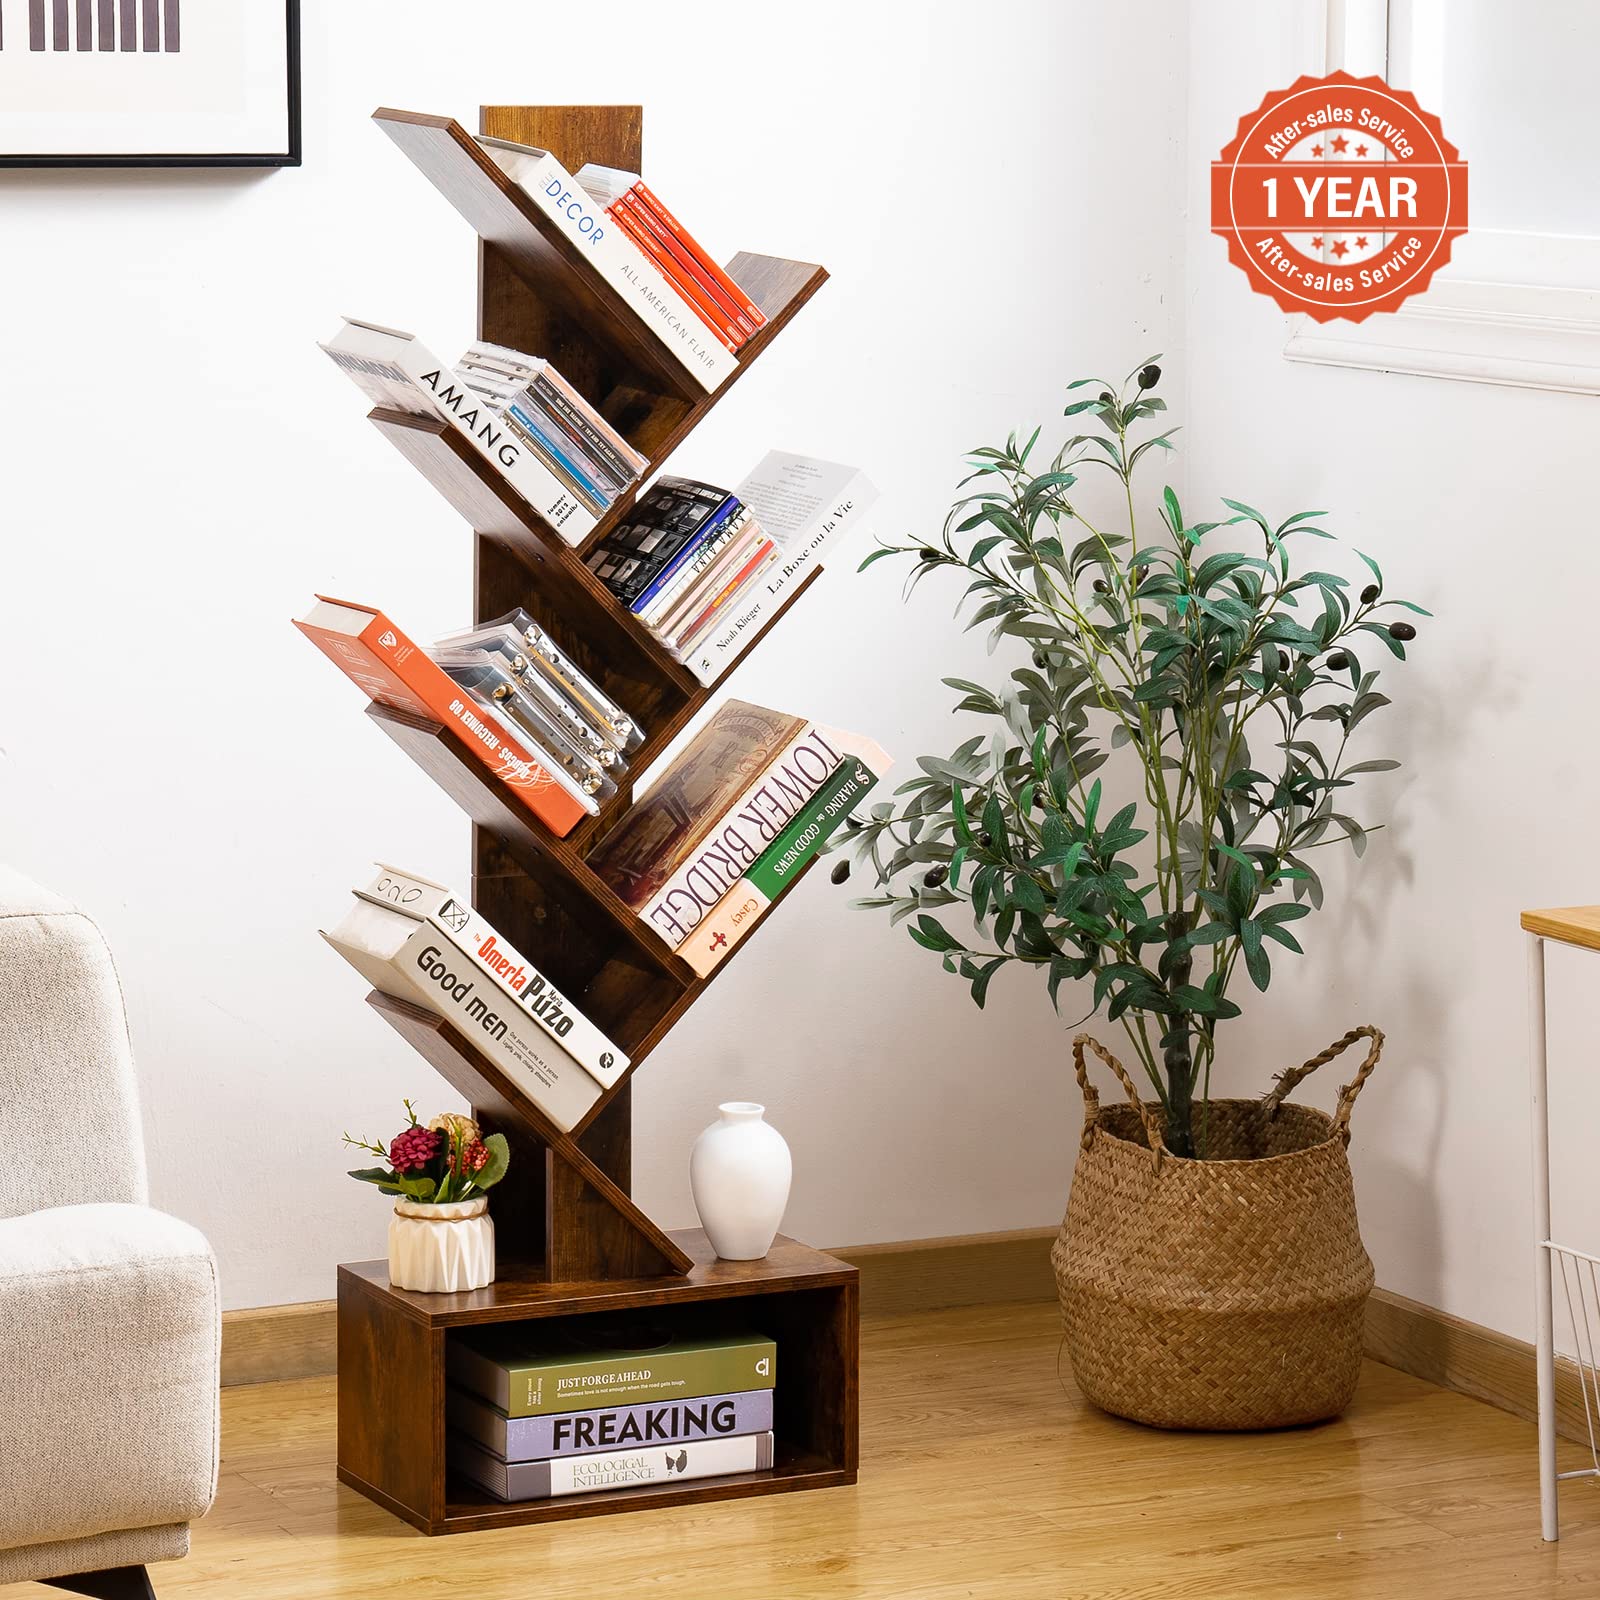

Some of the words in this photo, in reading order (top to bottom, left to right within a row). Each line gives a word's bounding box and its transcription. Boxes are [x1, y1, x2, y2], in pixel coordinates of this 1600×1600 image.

[546, 179, 604, 246] DECOR
[622, 212, 635, 226] SUPER
[633, 224, 645, 238] MARIO
[634, 202, 646, 215] SUPER
[645, 213, 656, 227] MARIO
[620, 264, 688, 341] ALL-AMERICAN
[687, 338, 716, 370] FLAIR
[420, 370, 521, 468] AMANG
[767, 578, 785, 595] La
[782, 549, 810, 578] Boxe
[810, 533, 825, 549] ou
[822, 521, 836, 534] la
[833, 501, 854, 519] Vie
[716, 629, 738, 651] Noah
[735, 603, 762, 631] Klieger
[460, 710, 500, 750] RELCOMEX
[738, 728, 846, 844] TOWER
[773, 846, 800, 876] NEWS
[794, 823, 820, 852] GOOD
[650, 824, 760, 946] BRIDGE
[731, 897, 760, 928] Casey
[416, 945, 473, 1003] Good
[518, 973, 574, 1038] Puzo
[557, 1378, 582, 1391] JUST
[581, 1373, 616, 1387] FORGE
[616, 1370, 652, 1383] AHEAD
[557, 1390, 584, 1398] Sometimes
[553, 1400, 736, 1450] FREAKING
[573, 1467, 655, 1488] INTELLIGENCE
